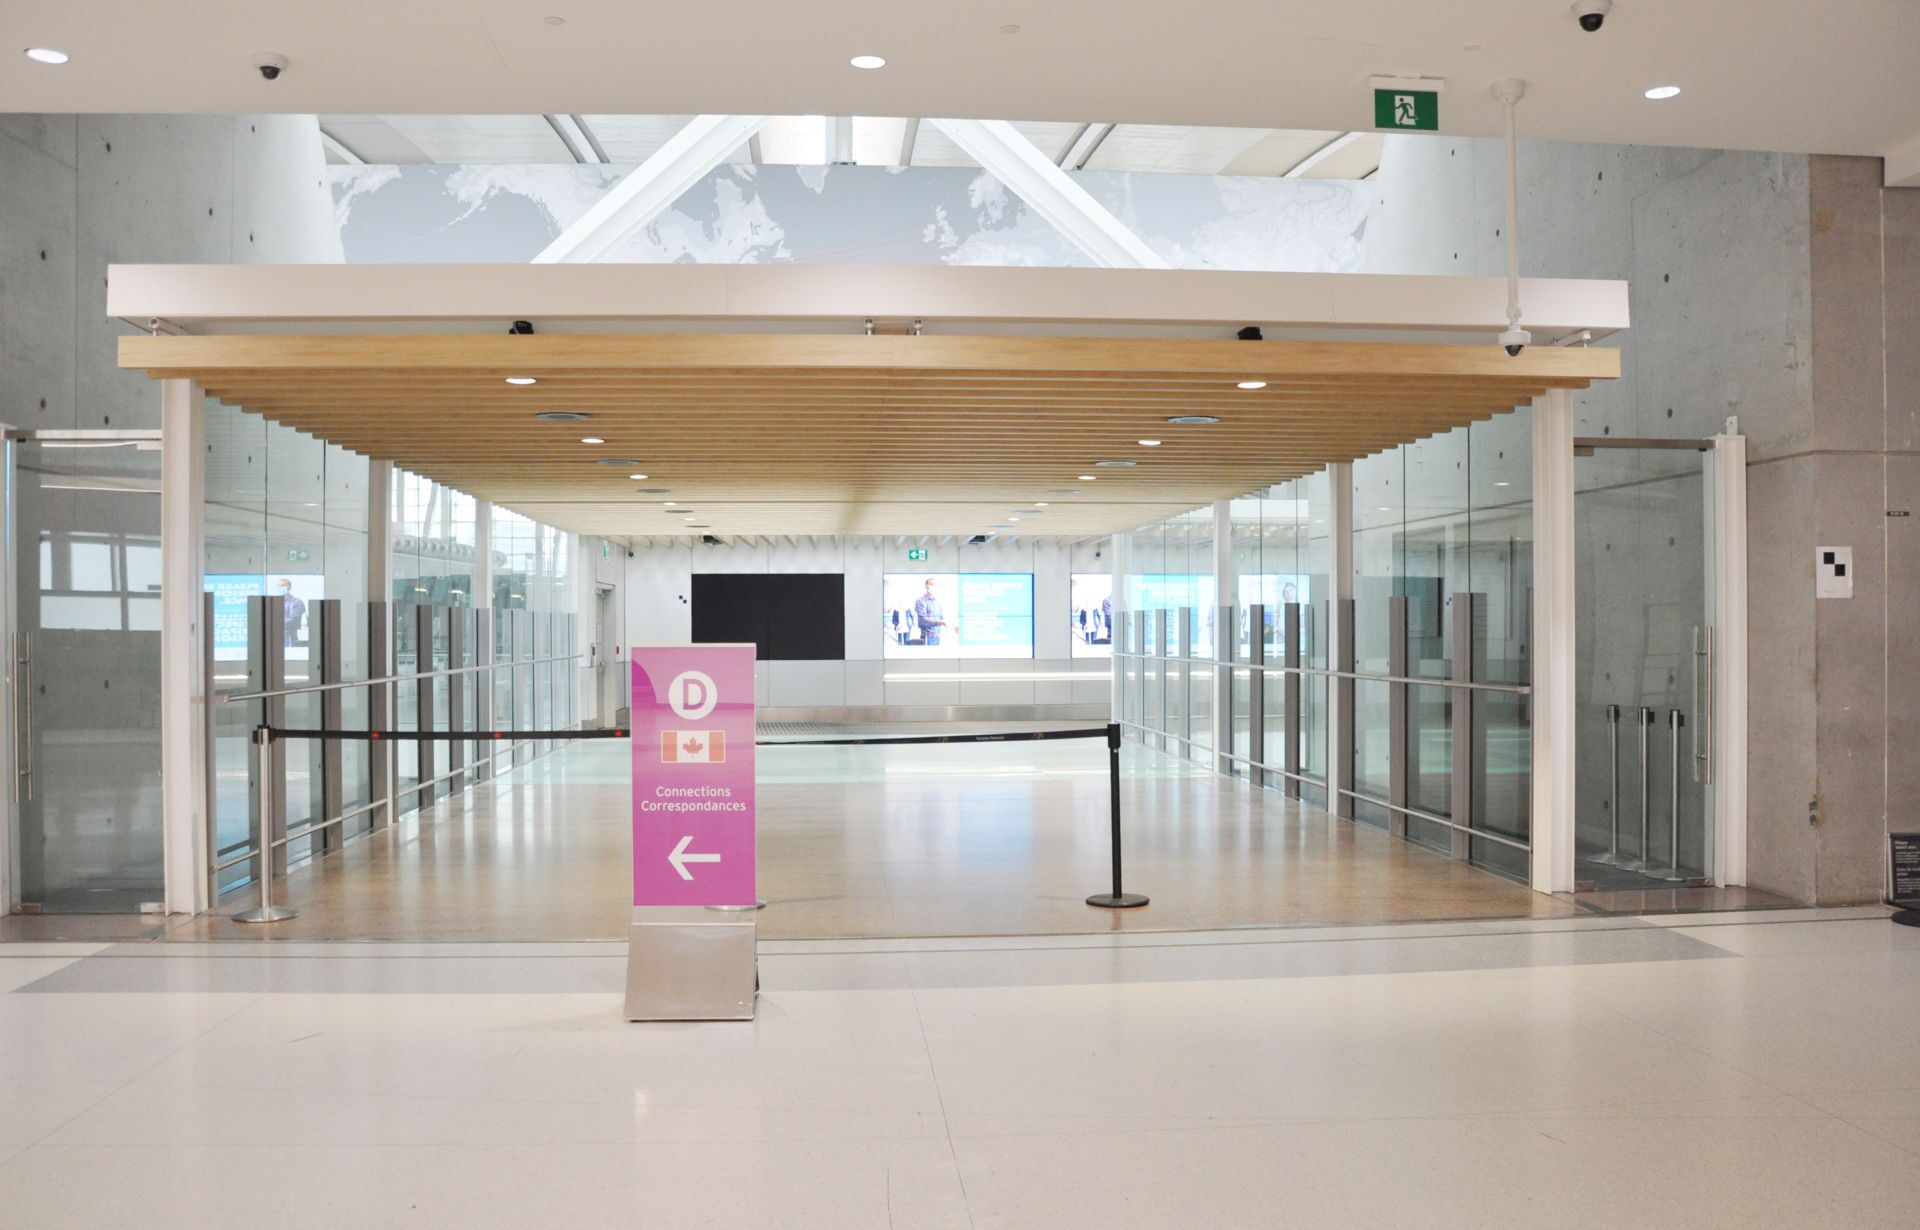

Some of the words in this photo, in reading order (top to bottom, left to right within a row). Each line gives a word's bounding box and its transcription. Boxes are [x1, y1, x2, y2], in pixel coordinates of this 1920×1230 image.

[682, 678, 707, 710] D
[655, 786, 731, 797] Connections
[641, 800, 746, 813] Correspondances
